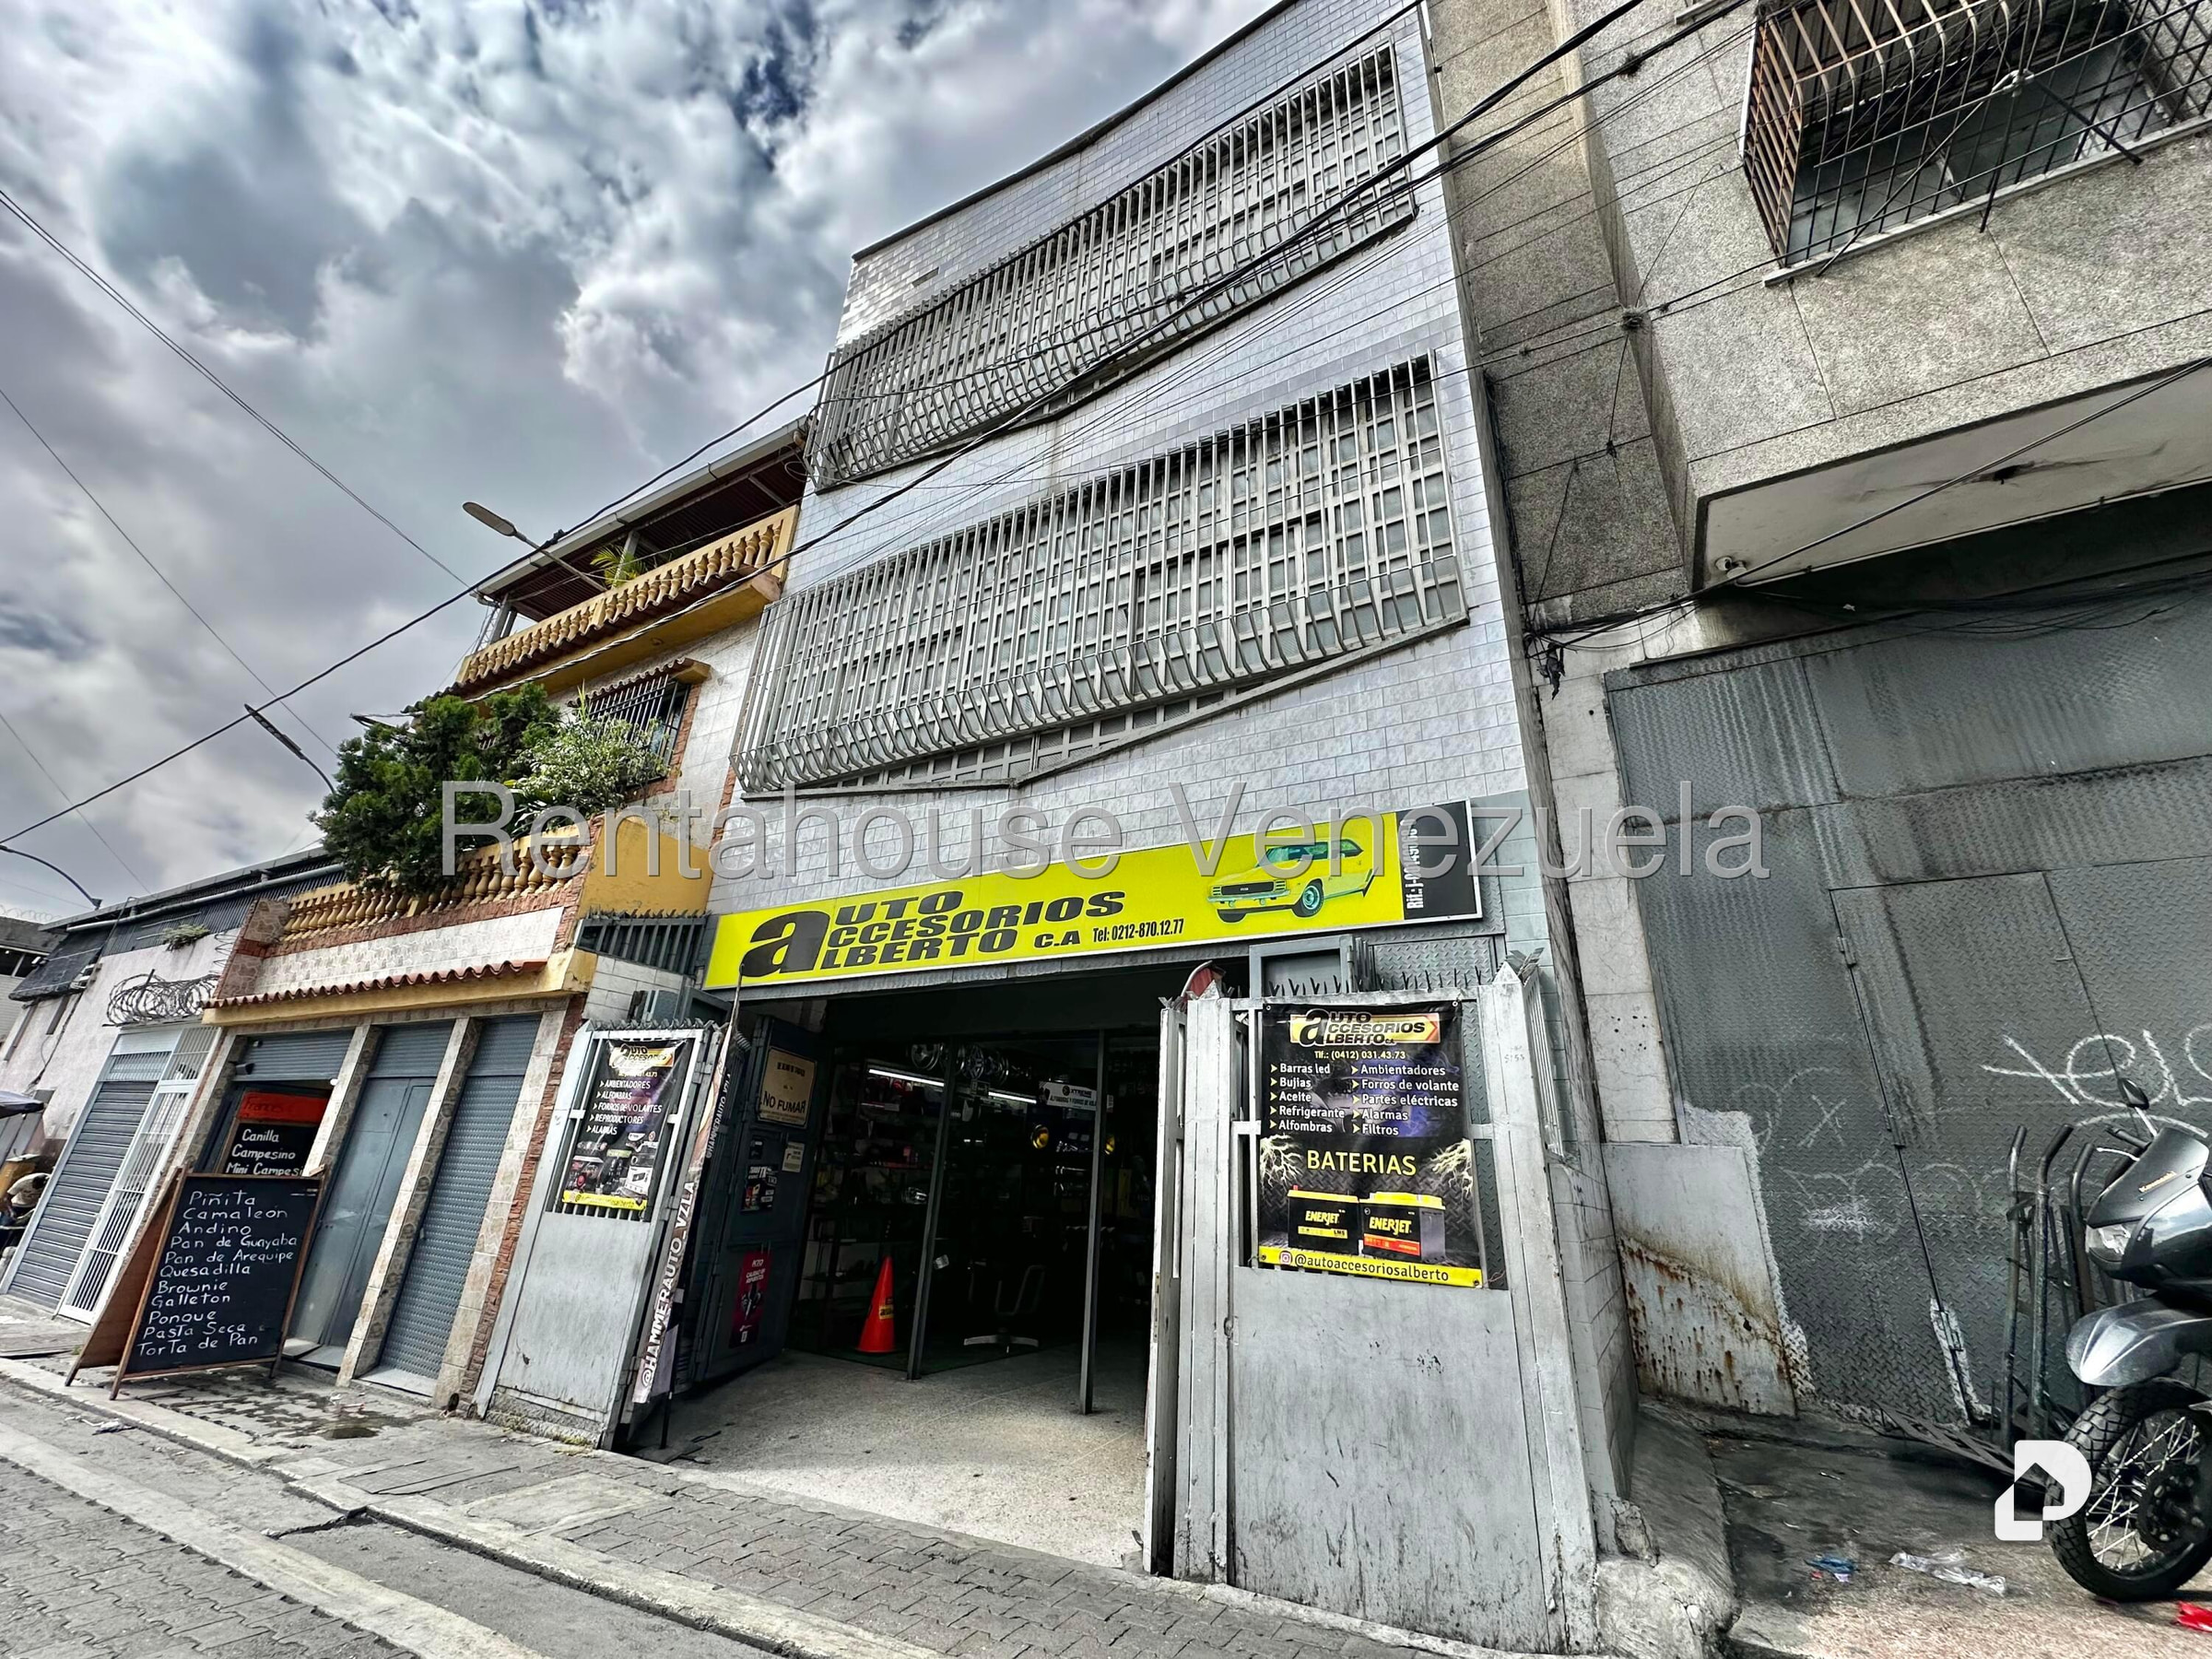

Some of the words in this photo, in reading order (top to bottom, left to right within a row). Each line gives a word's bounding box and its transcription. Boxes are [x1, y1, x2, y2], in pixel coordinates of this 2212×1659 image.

[1093, 927, 1110, 943] Tel:
[1112, 918, 1184, 940] 0212-870.12.77
[1314, 1051, 1328, 1059] Tlf.:
[1332, 1051, 1359, 1060] (0412)
[1362, 1051, 1406, 1059] 031.43.73
[1279, 1064, 1312, 1074] Barras
[1315, 1064, 1331, 1074] led
[1360, 1065, 1446, 1076] Ambientadores
[1279, 1077, 1312, 1088] Bujias
[1361, 1080, 1395, 1089] Forros
[1399, 1080, 1413, 1090] de
[1416, 1080, 1460, 1091] volante
[601, 1091, 632, 1100] ALFOMBRAS
[763, 1090, 776, 1109] NO
[777, 1100, 806, 1114] FUMAR
[1279, 1091, 1312, 1102] Aceite
[1362, 1095, 1397, 1105] Partes
[1400, 1094, 1458, 1107] eléctricas
[628, 1104, 663, 1113] VOLANTES
[1279, 1105, 1345, 1119] Refrigerante
[1362, 1109, 1408, 1121] Alarmas
[1278, 1120, 1333, 1133] Alfombras
[1362, 1124, 1399, 1135] Filtros
[241, 1128, 279, 1143] Canilla
[231, 1144, 296, 1161] Campesino
[226, 1162, 249, 1174] Mini
[1307, 1150, 1417, 1176] BATERIAS
[189, 1190, 255, 1206] Piñita
[1305, 1210, 1340, 1226] ENERJET
[178, 1221, 252, 1235] Andino
[1370, 1216, 1412, 1237] ENERJET
[171, 1236, 205, 1249] Pan
[216, 1236, 231, 1247] de
[241, 1232, 298, 1250] Guayaba
[164, 1251, 194, 1265] Pan
[206, 1251, 225, 1262] de
[232, 1249, 294, 1264] Arequipe
[160, 1263, 251, 1277] Quesadilla
[1295, 1253, 1449, 1281] @autoaccesoriosalberto
[157, 1279, 229, 1294] Brownie
[641, 1182, 695, 1387] @HAMMERAUTO_VZLA
[151, 1293, 230, 1309] Galleton
[202, 1322, 246, 1335] Seca
[198, 1336, 218, 1349] de
[229, 1332, 258, 1347] Pan
